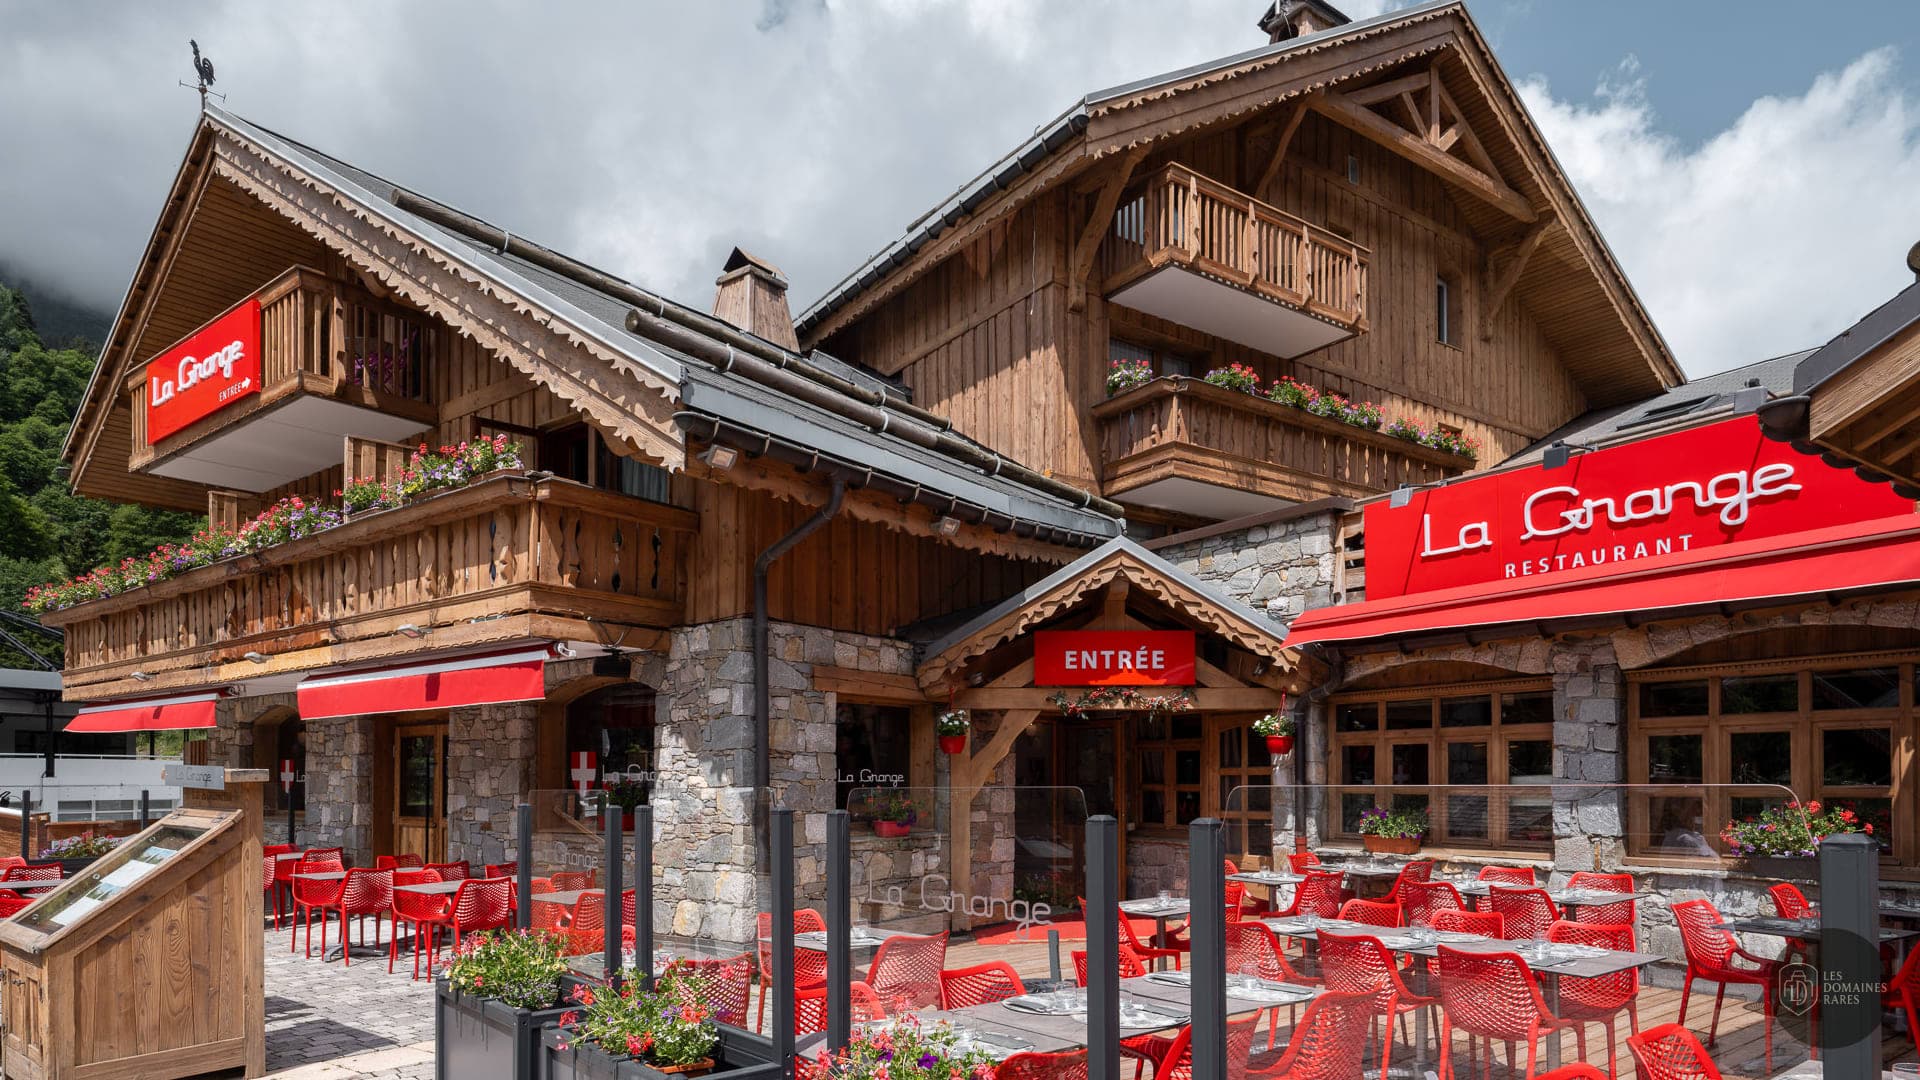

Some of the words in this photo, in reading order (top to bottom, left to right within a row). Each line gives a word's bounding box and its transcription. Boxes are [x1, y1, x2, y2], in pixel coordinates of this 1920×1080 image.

[152, 377, 175, 406] La
[177, 341, 245, 391] Grange
[1420, 513, 1493, 557] La
[1519, 463, 1803, 527] Grange
[1505, 534, 1693, 578] RESTAURANT
[1065, 645, 1165, 670] ENTRÉE
[838, 768, 854, 783] La
[860, 768, 904, 788] Grange
[867, 867, 904, 906] La
[919, 873, 1054, 939] Grange
